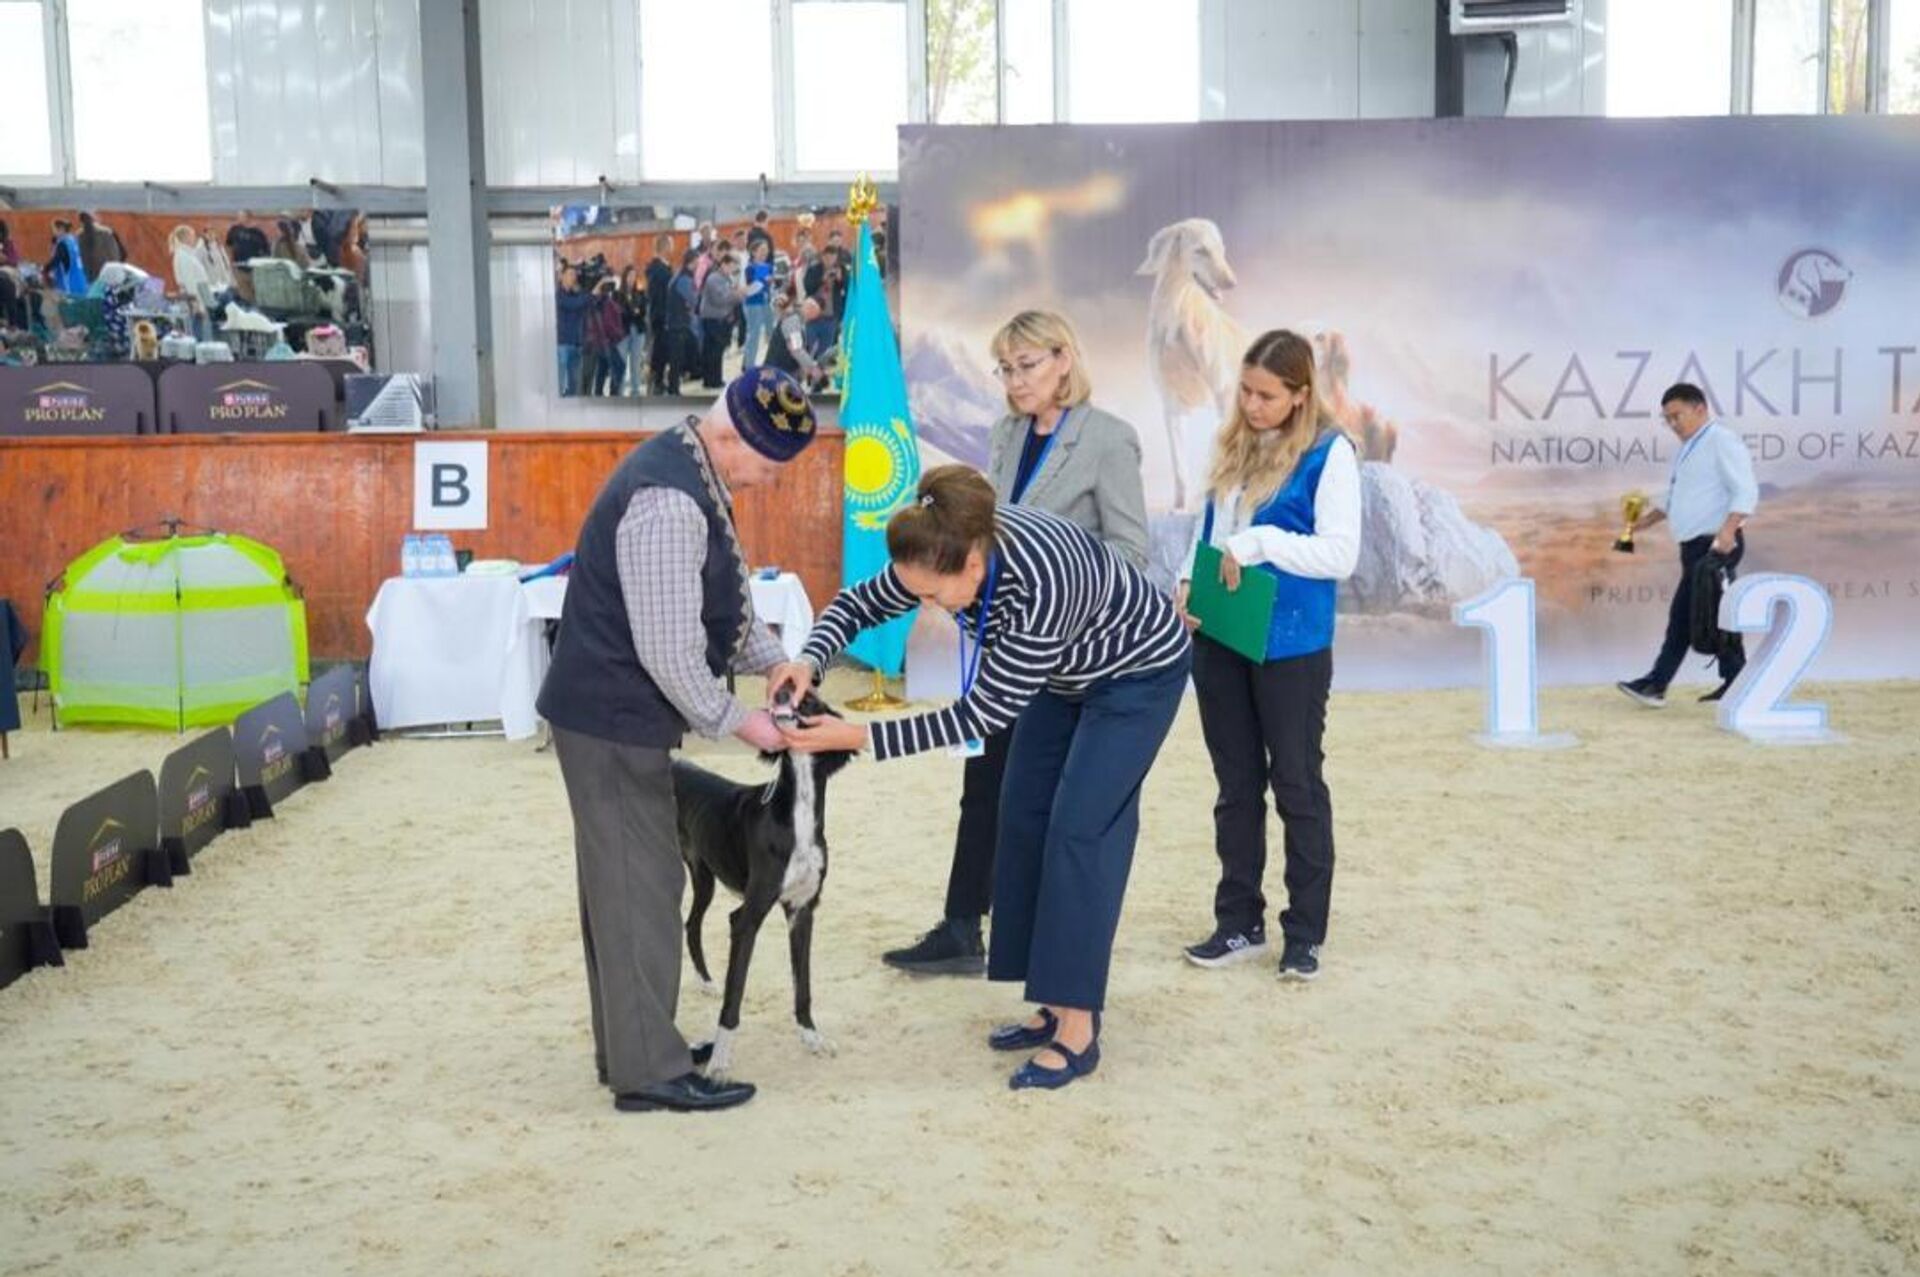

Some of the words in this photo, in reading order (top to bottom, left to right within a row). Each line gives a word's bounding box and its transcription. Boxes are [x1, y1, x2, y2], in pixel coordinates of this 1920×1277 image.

[1488, 346, 1843, 421] KAZAKH
[1877, 345, 1920, 414] T
[1491, 436, 1668, 465] NATIONAL
[1797, 432, 1846, 461] OF
[431, 463, 471, 507] B
[1826, 579, 1891, 599] REAT
[1451, 576, 1538, 736] 1
[1718, 571, 1834, 731] 2
